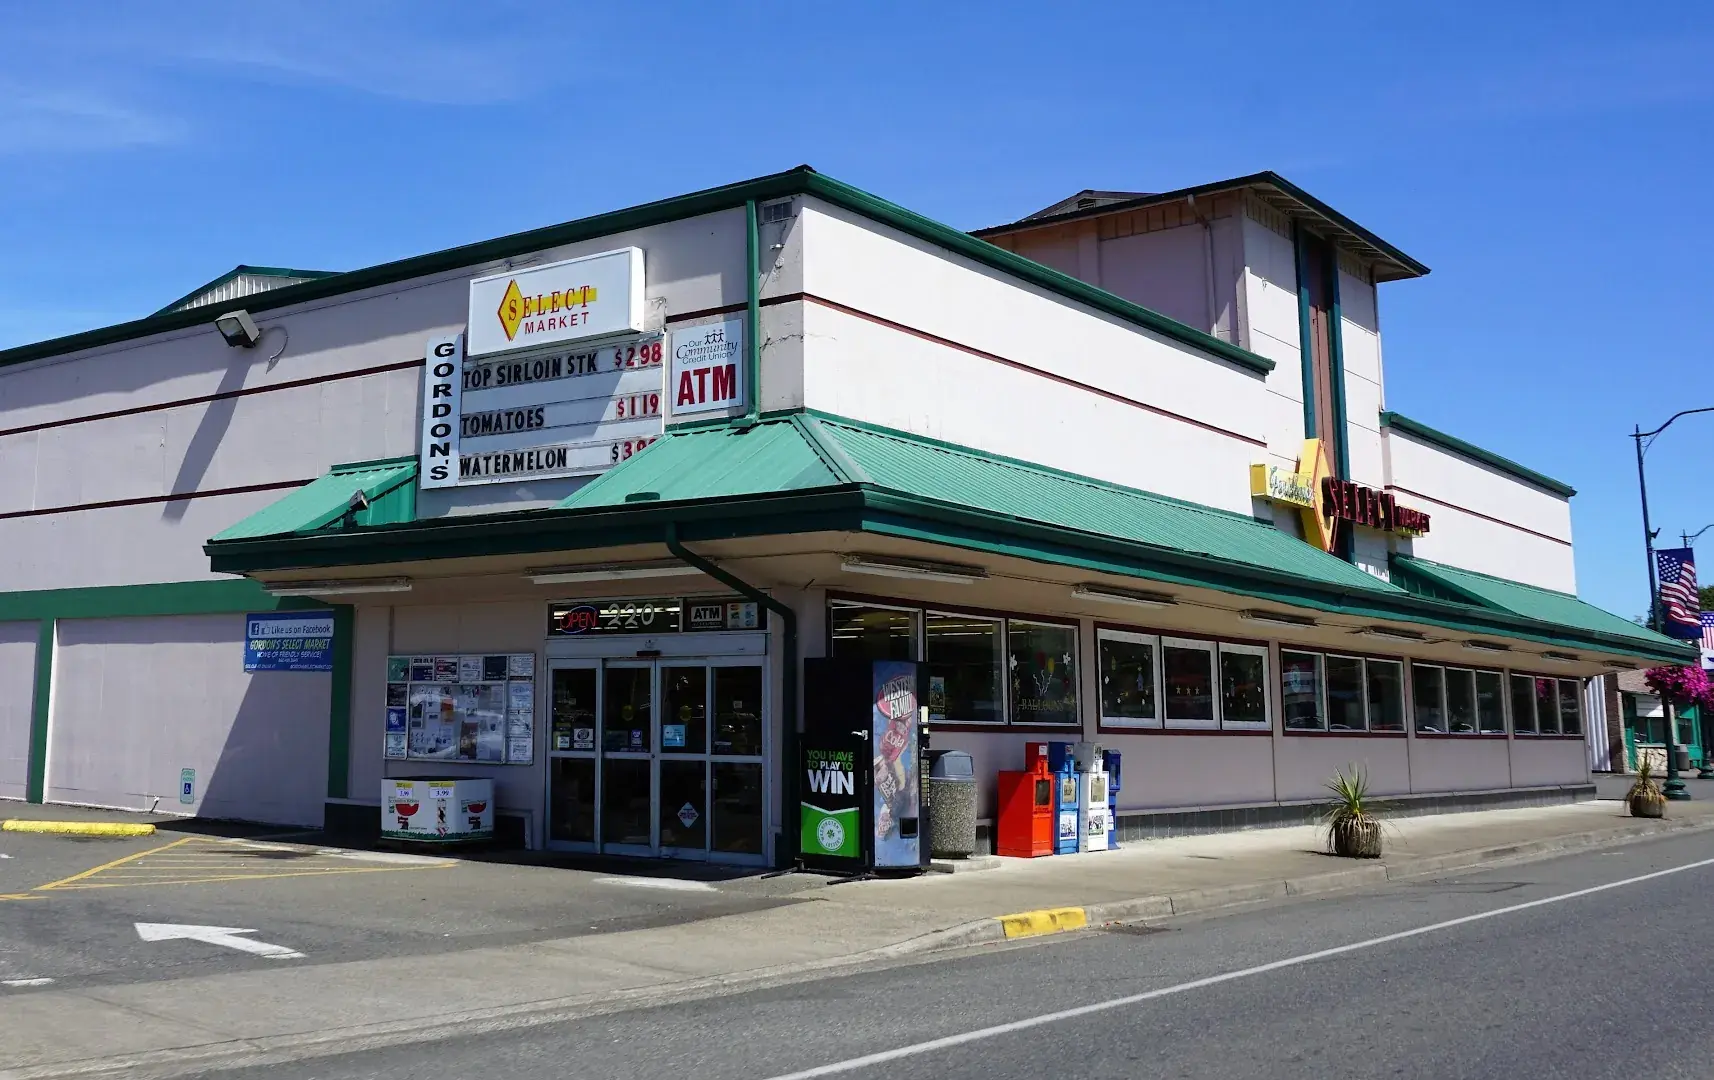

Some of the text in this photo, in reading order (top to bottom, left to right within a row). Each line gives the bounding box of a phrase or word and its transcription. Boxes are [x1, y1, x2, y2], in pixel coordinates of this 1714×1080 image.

[508, 285, 591, 321] SELECT
[524, 312, 589, 335] MARKET
[676, 340, 738, 359] Community
[688, 340, 702, 348] Our
[682, 351, 732, 365] Credit Union
[463, 368, 492, 389] TOP
[497, 357, 561, 384] SIRLOIN
[567, 353, 597, 374] STK
[677, 364, 736, 406] ATM
[429, 342, 456, 482] GORDON'S
[462, 407, 545, 438] TOMATOES
[459, 448, 567, 477] WATERMELON
[559, 611, 597, 629] OPEN
[607, 602, 655, 626] 220
[693, 606, 720, 620] ATM
[271, 625, 284, 635] Like
[294, 626, 301, 634] on
[302, 624, 331, 634] Facebook
[282, 638, 303, 650] SELECT
[304, 638, 331, 649] MARKET
[885, 730, 905, 748] Cola
[807, 749, 854, 762] YOU HAVE
[807, 760, 853, 771] TO PLAY TO
[807, 769, 855, 796] WIN
